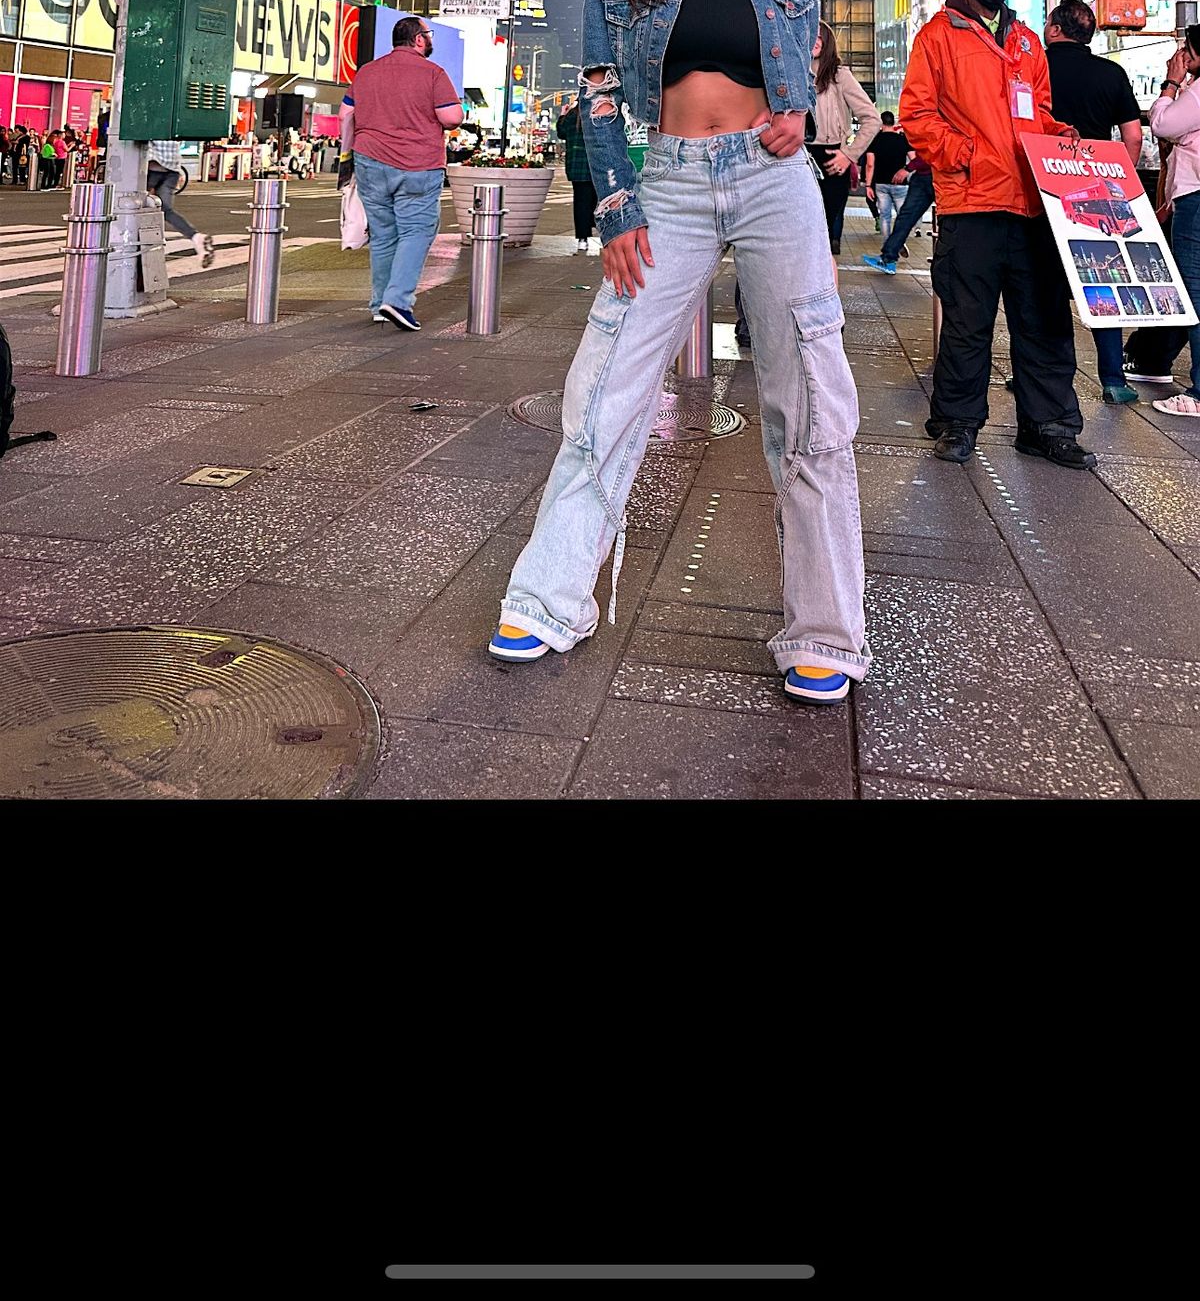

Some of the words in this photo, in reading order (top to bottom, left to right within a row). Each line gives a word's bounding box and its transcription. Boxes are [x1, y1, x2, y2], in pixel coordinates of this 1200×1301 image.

[473, 0, 487, 7] FLOW
[481, 8, 501, 16] MOVING
[1042, 157, 1091, 177] ICONIC
[1091, 162, 1127, 179] TOUR
